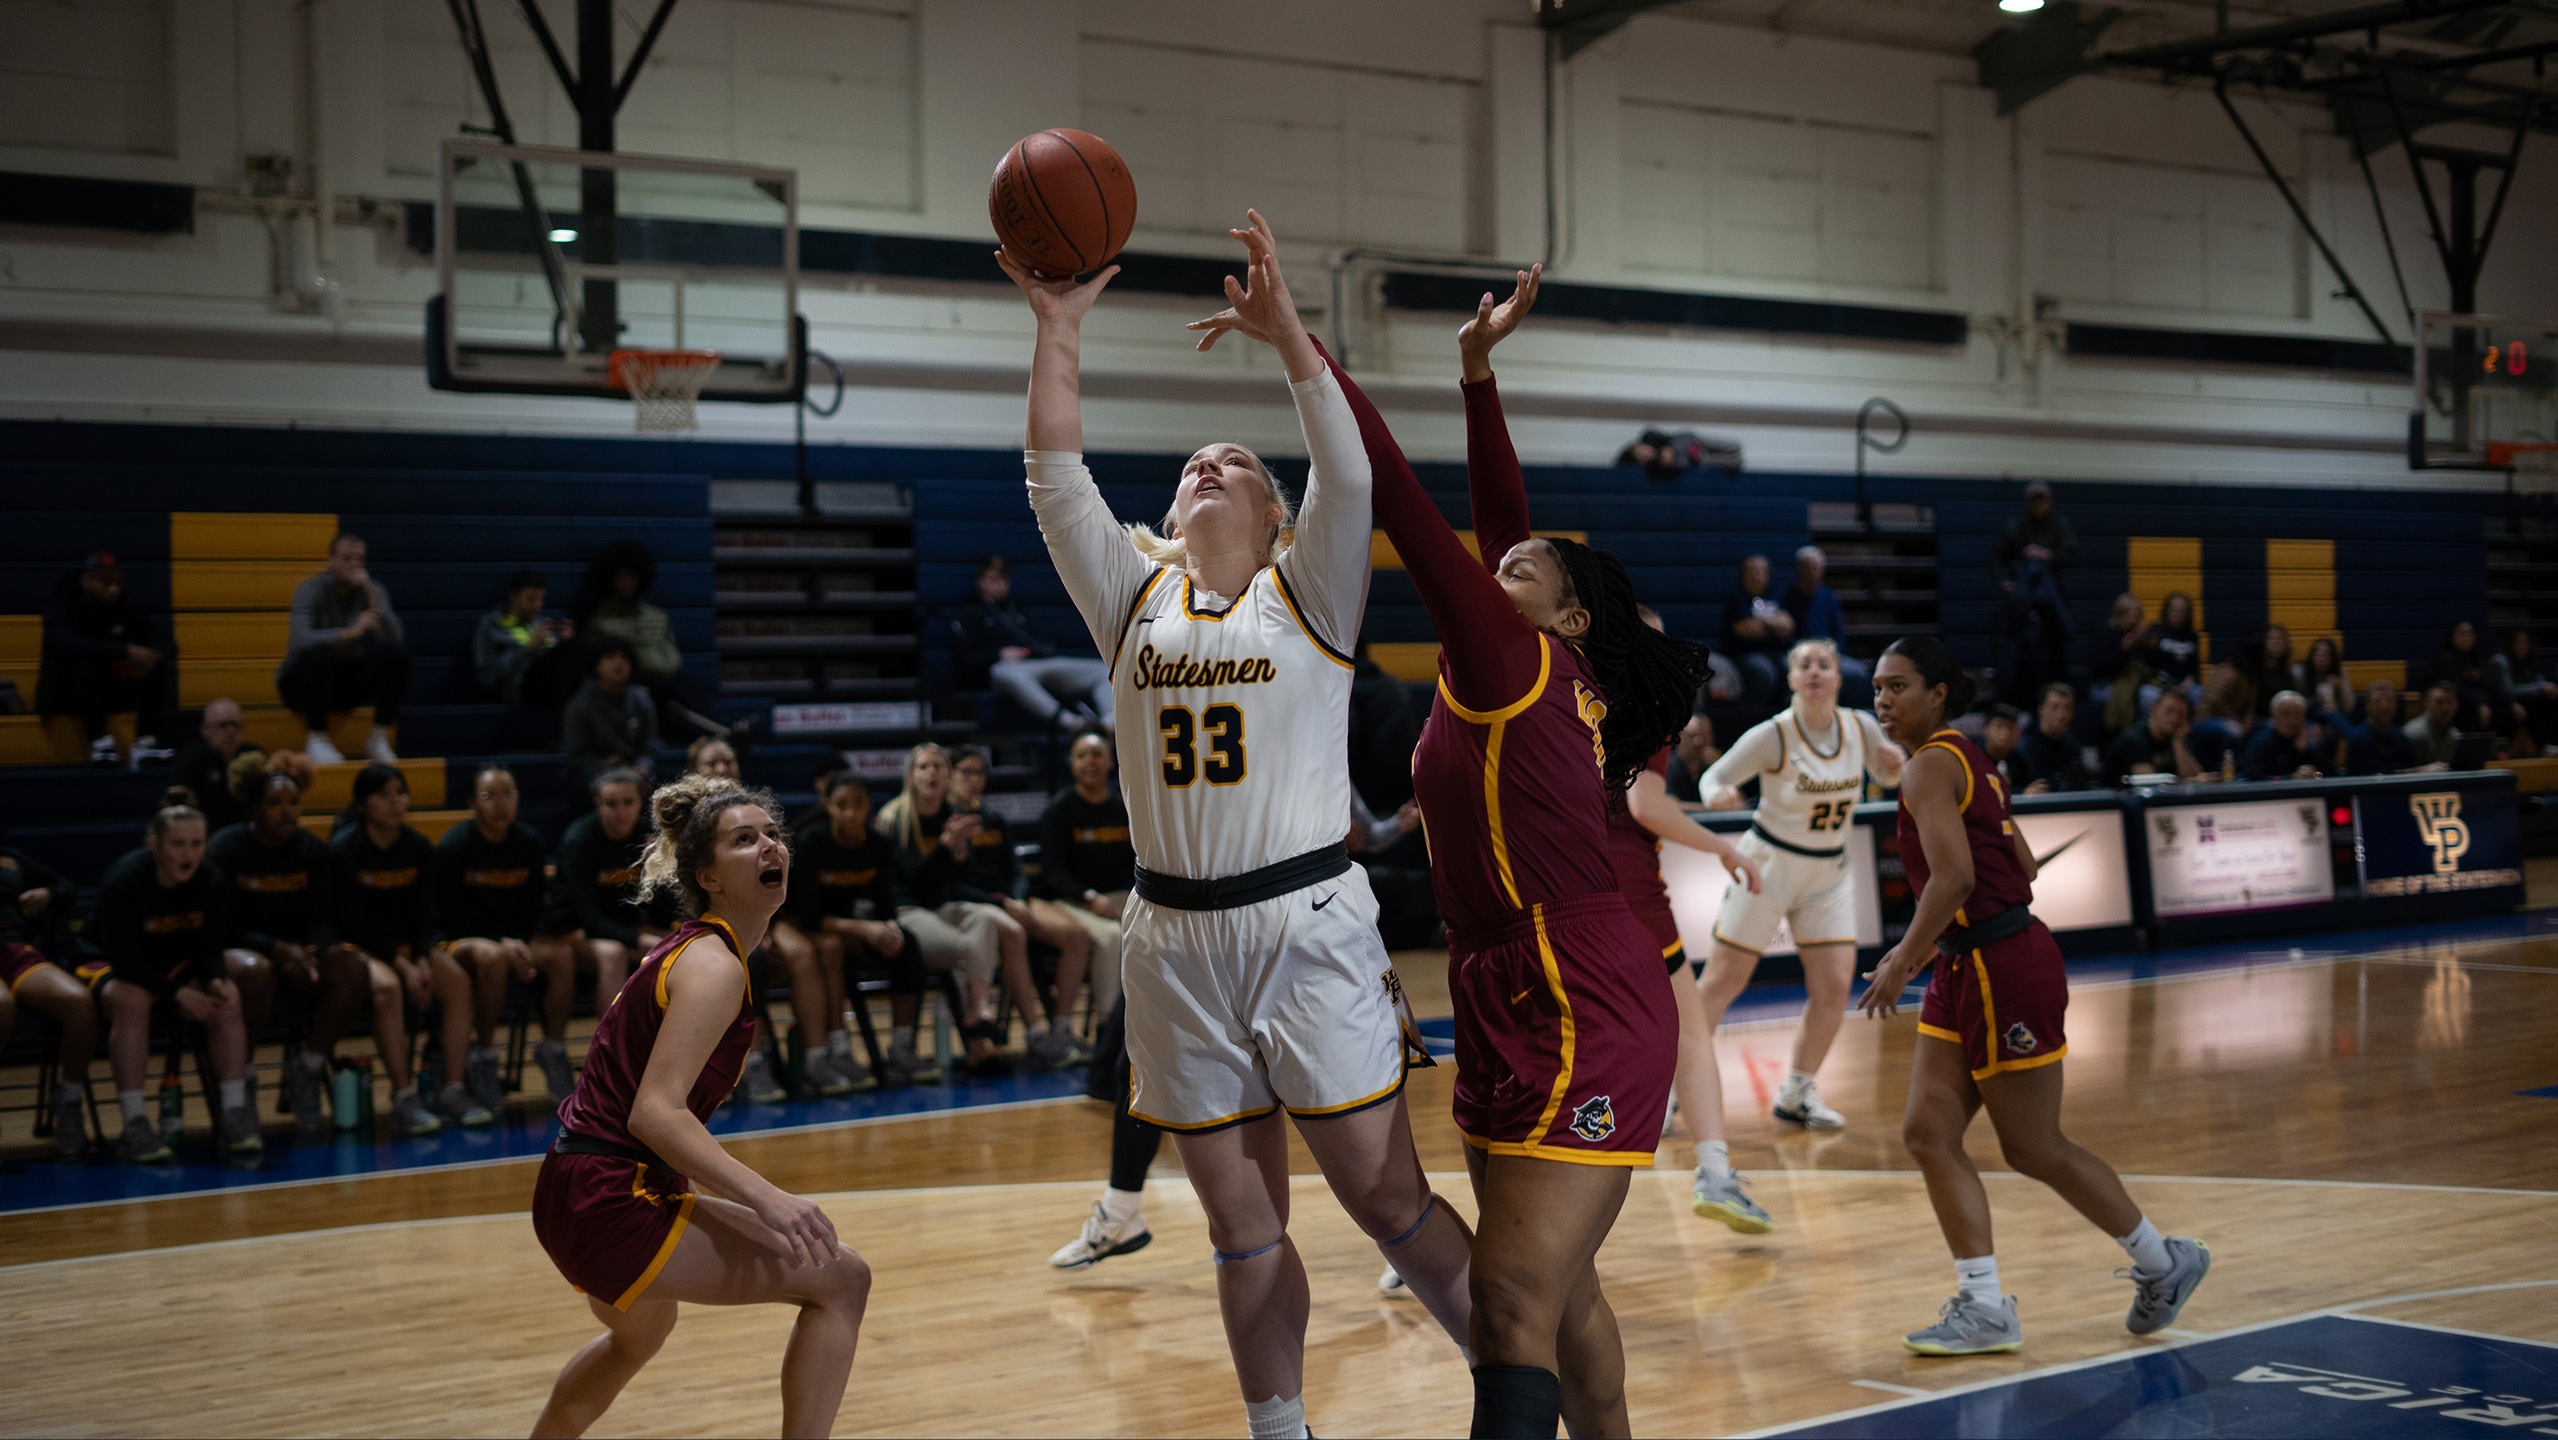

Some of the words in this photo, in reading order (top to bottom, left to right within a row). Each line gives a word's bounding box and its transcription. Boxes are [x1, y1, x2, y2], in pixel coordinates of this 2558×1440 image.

[1134, 643, 1277, 691] Statesmen
[1159, 701, 1248, 789] 33
[1809, 800, 1853, 830] 25
[2231, 1364, 2558, 1436] RICA
